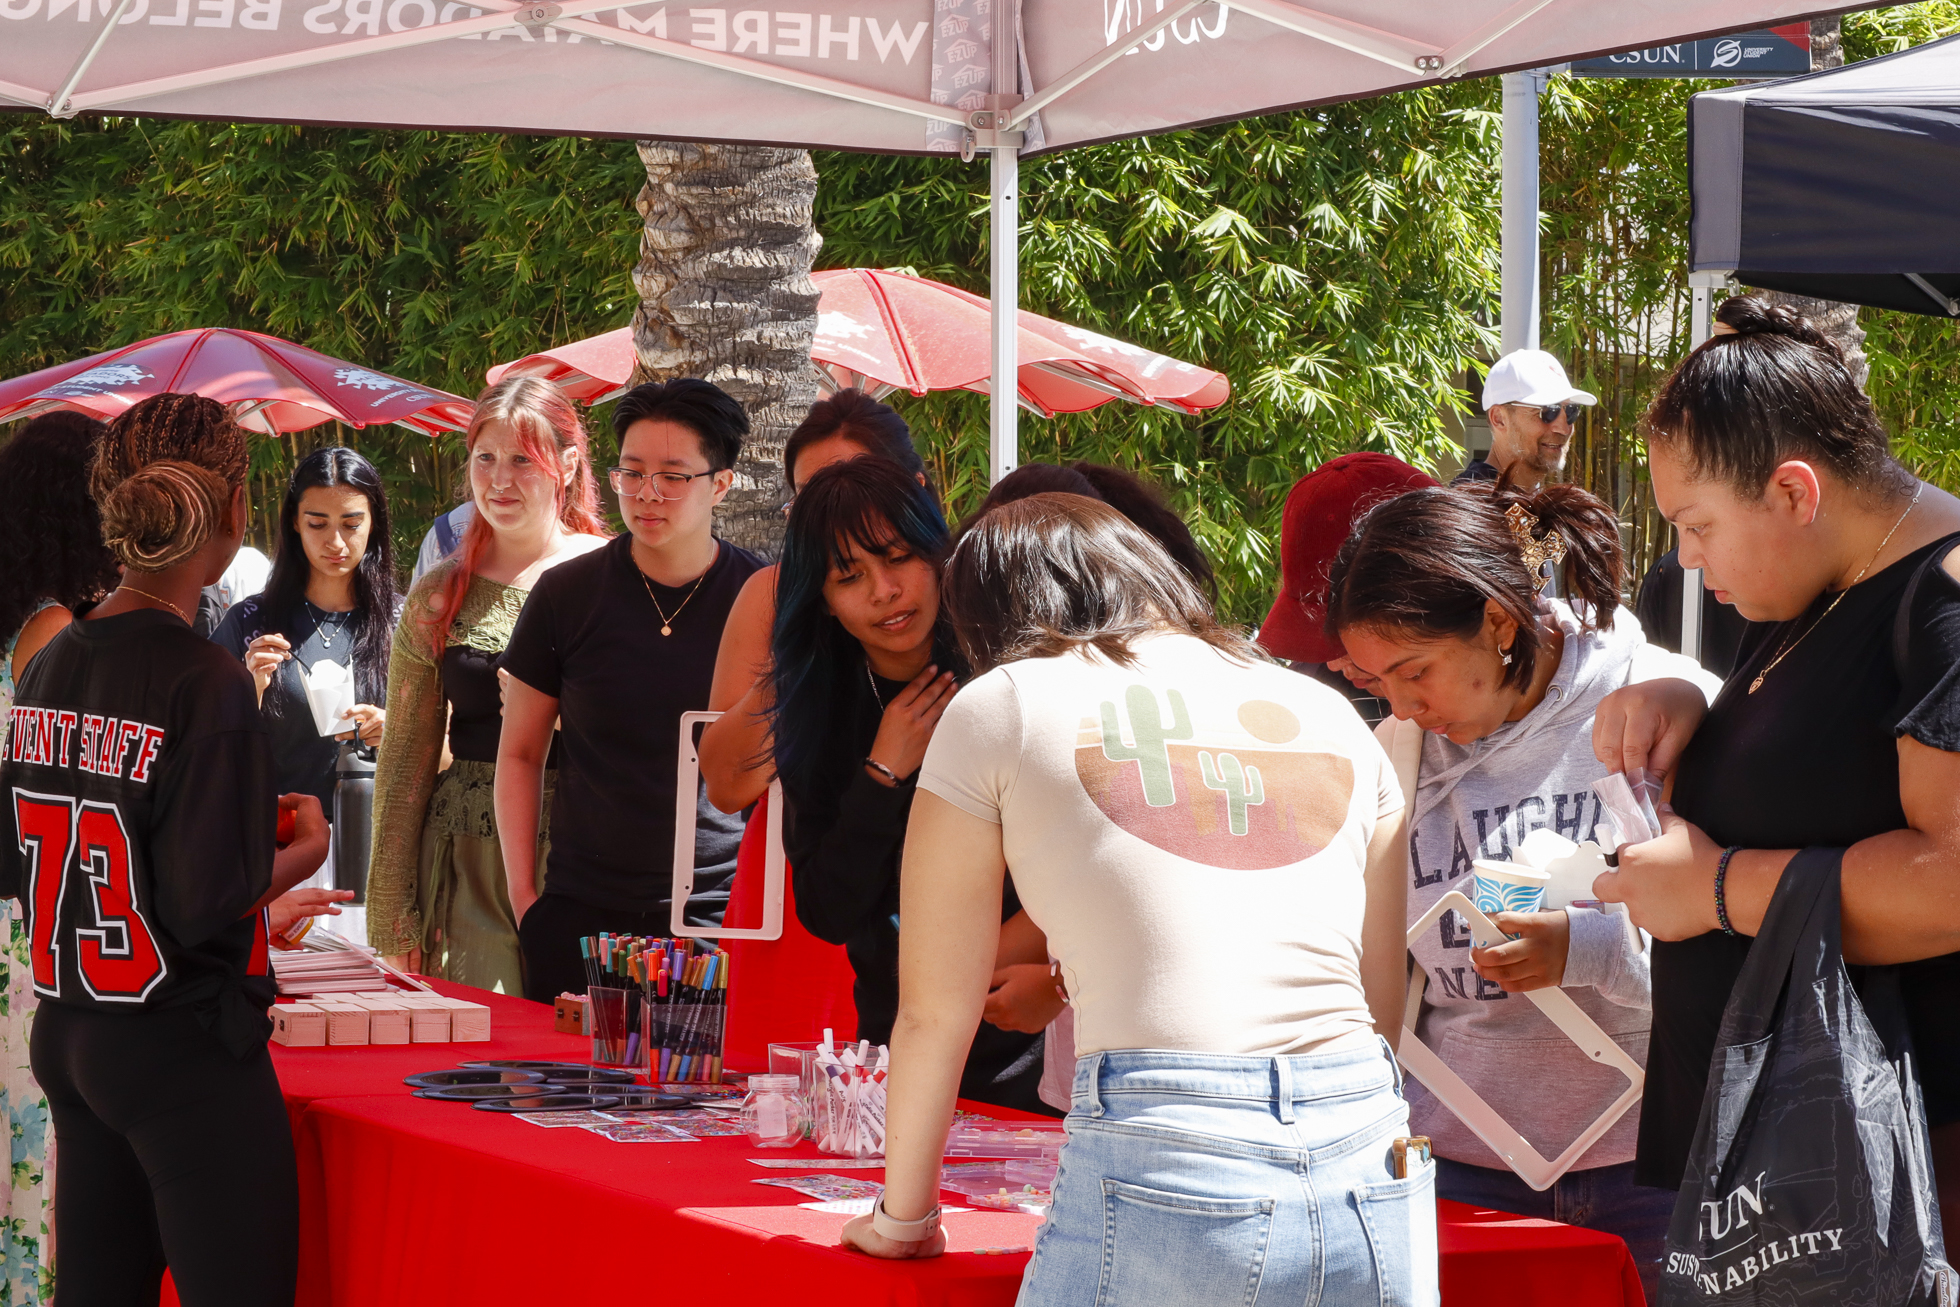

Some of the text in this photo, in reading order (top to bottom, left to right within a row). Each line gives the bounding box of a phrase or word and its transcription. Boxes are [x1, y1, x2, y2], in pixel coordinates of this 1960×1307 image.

[78, 714, 164, 783] STAFF
[12, 787, 167, 1003] 73
[1699, 1171, 1766, 1241] UN
[1667, 1228, 1843, 1295] SUSTNABILITY
